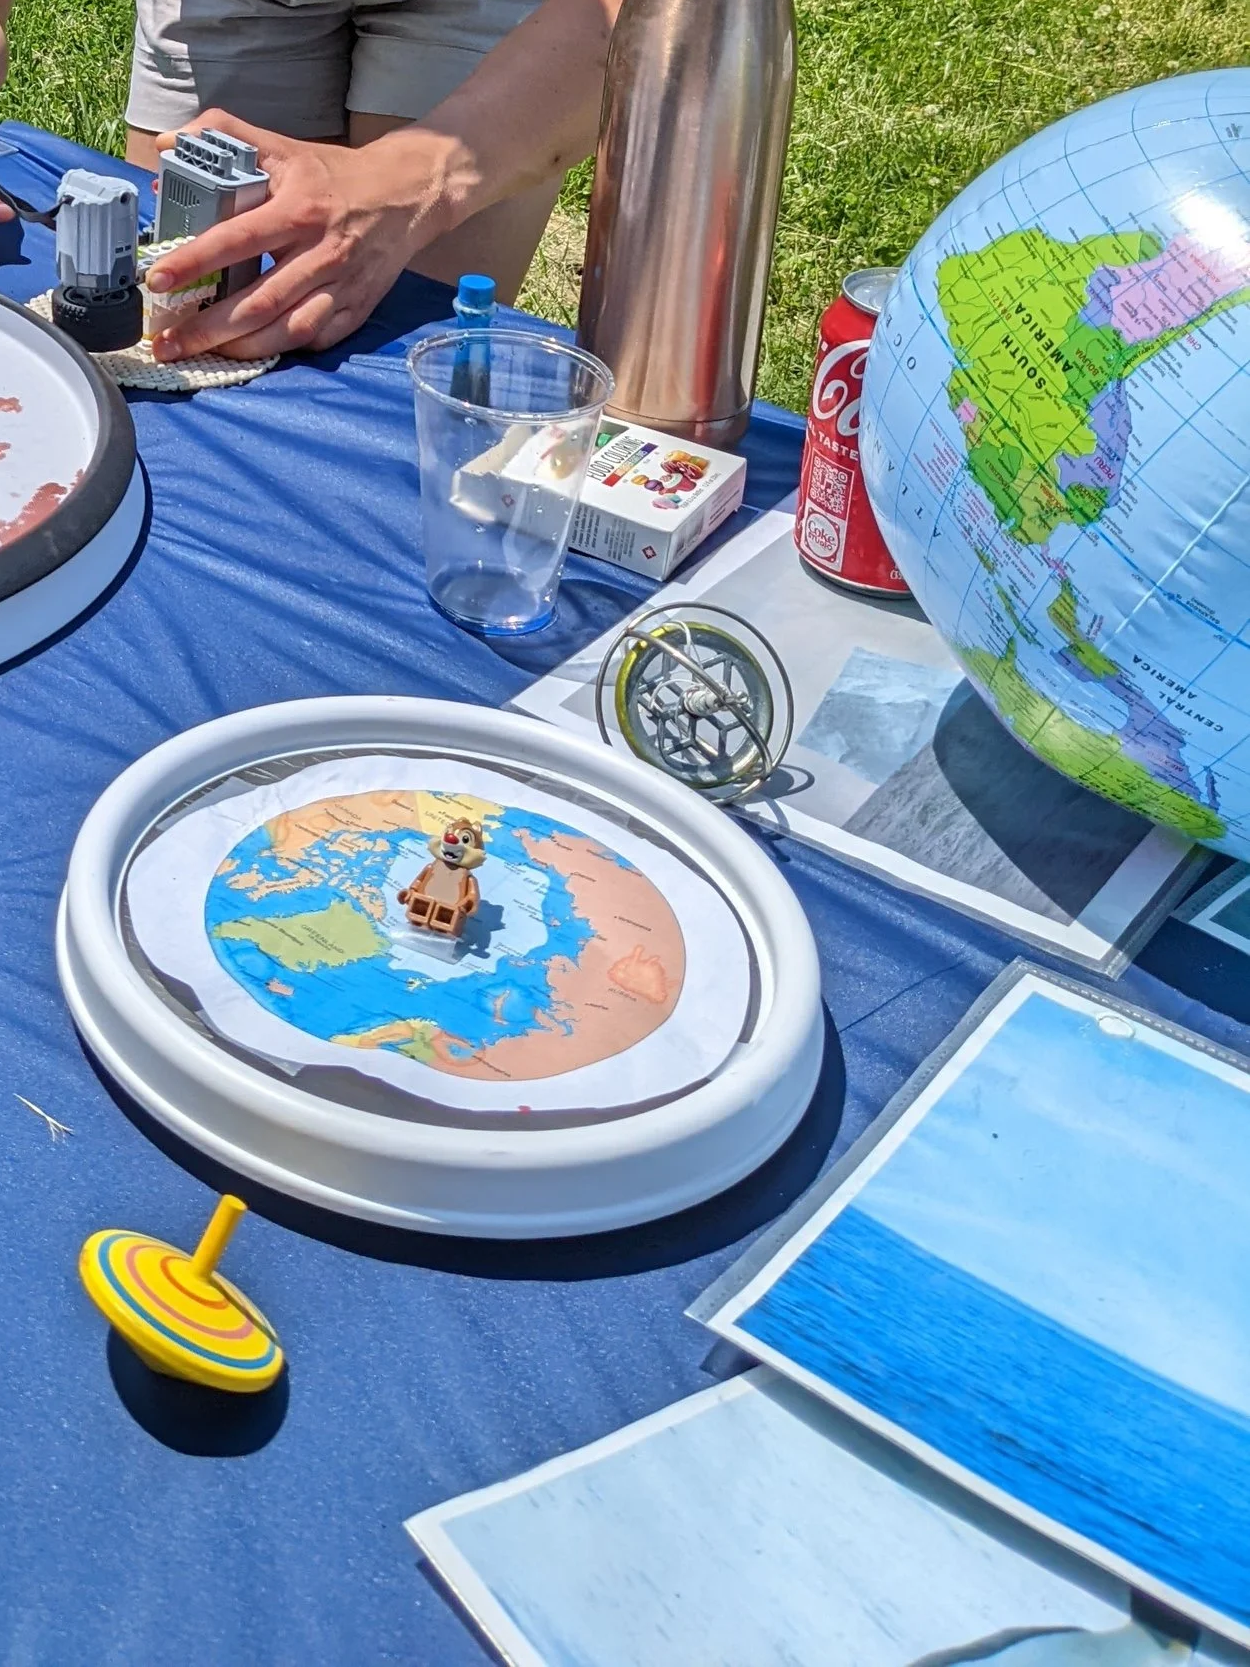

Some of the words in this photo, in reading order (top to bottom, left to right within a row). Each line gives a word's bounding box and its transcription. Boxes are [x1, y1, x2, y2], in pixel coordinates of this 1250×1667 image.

[985, 288, 1013, 320] BRAZIL
[1011, 300, 1073, 374] AMERICA
[1180, 329, 1202, 351] CHILE
[999, 334, 1047, 390] SOUTH
[1073, 346, 1100, 377] BOLIVIA
[600, 435, 645, 464] COLORING
[818, 430, 859, 461] TASTE
[586, 458, 615, 481] FOOD
[1092, 454, 1115, 480] PERU
[808, 519, 835, 543] Coke
[1130, 653, 1197, 700] AMERICA
[1156, 690, 1224, 733] CENTRAL
[301, 924, 345, 954] GREENLAND
